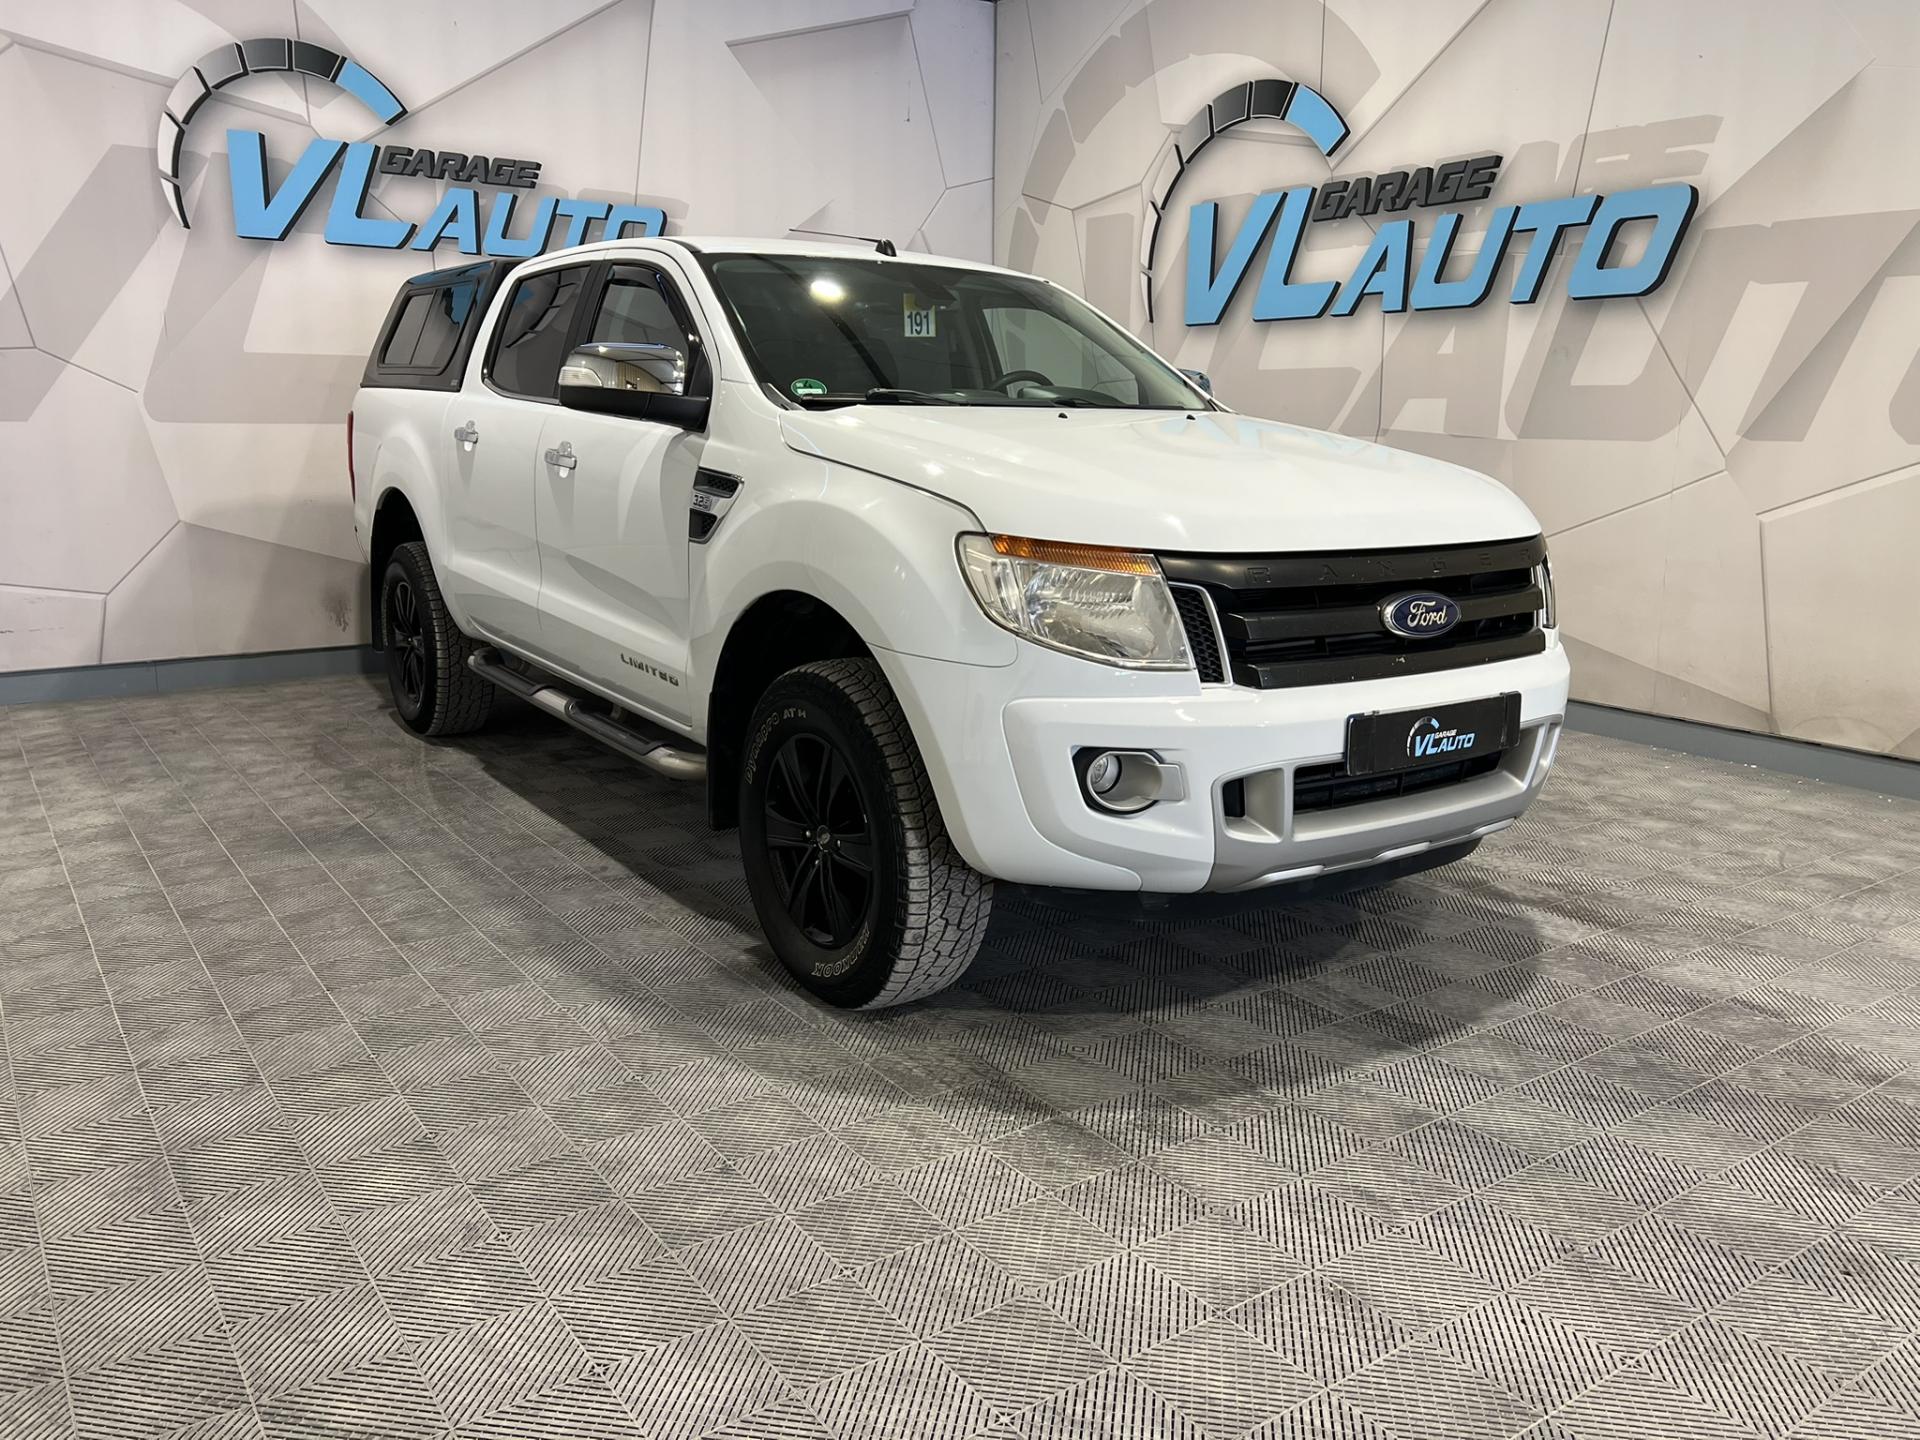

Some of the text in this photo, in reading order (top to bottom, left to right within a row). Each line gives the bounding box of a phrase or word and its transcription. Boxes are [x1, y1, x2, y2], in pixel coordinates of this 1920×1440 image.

[379, 144, 542, 189] GARAGE
[1312, 155, 1504, 222] GARAGE
[907, 311, 930, 336] 191
[1406, 600, 1448, 628] Ford
[619, 652, 680, 688] LIMITED
[1434, 729, 1458, 740] GARAGE
